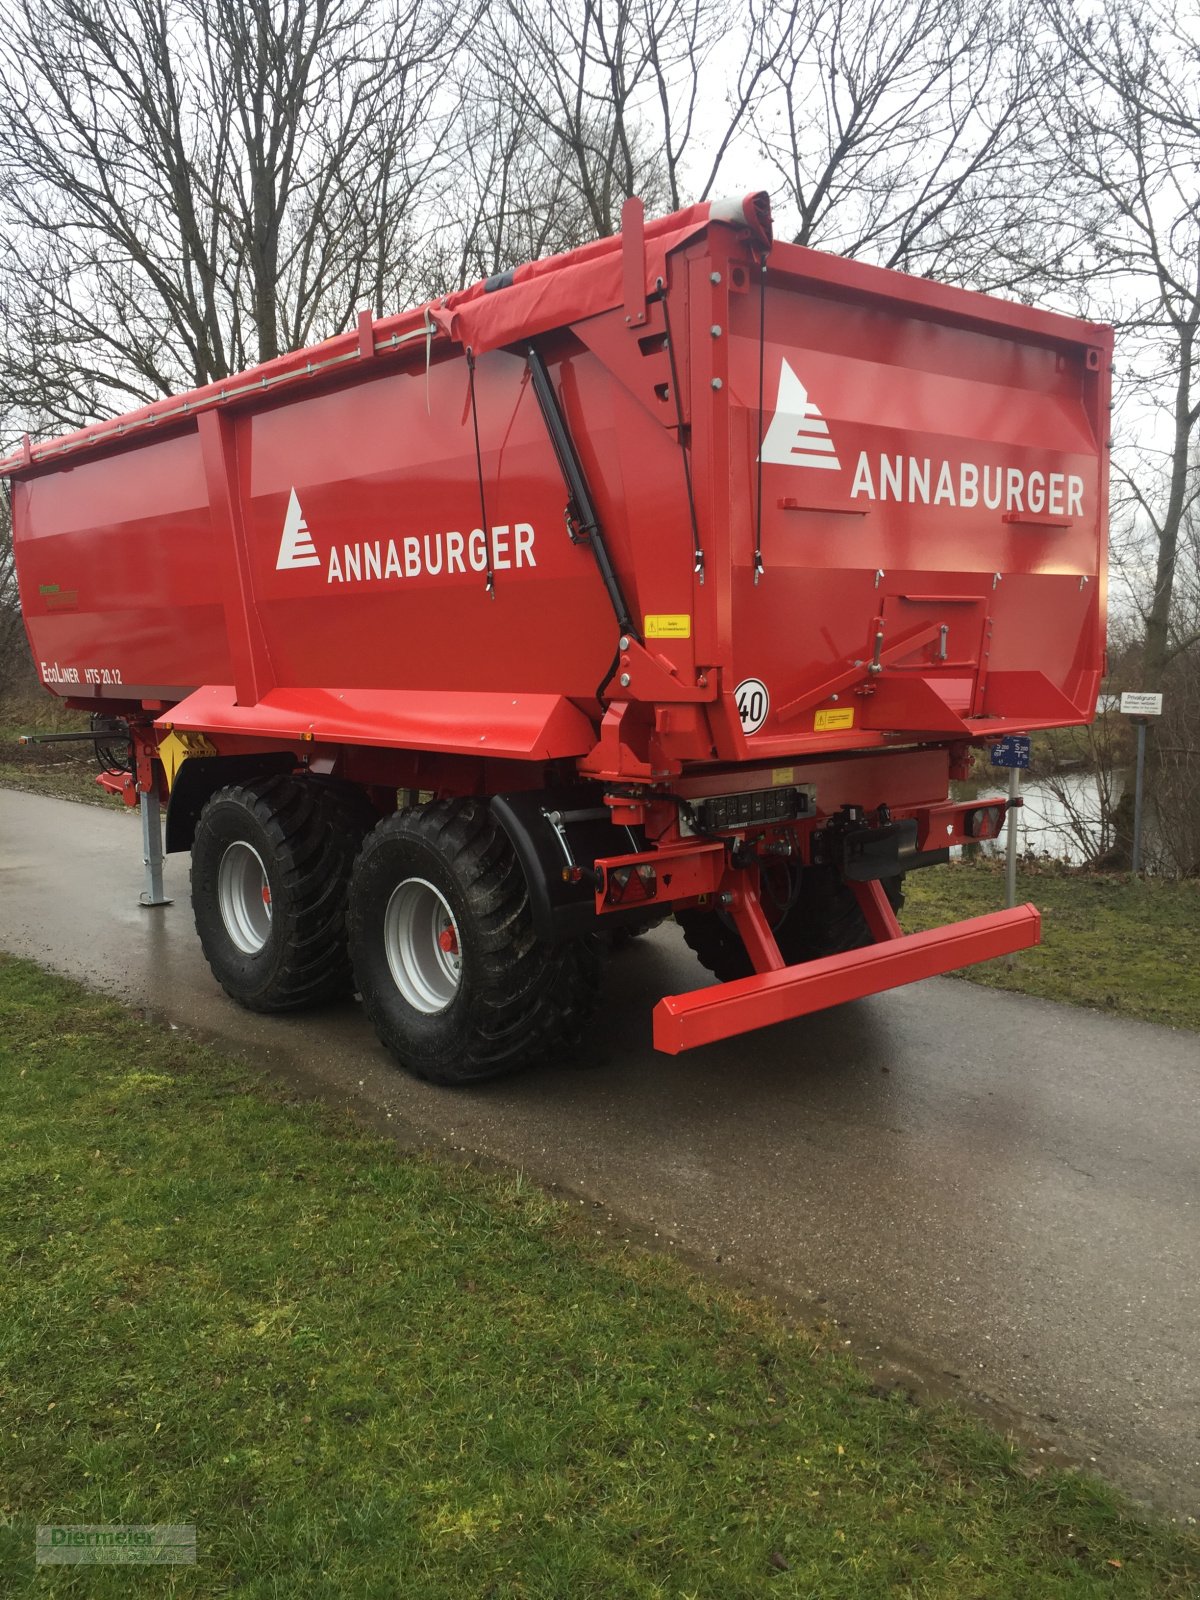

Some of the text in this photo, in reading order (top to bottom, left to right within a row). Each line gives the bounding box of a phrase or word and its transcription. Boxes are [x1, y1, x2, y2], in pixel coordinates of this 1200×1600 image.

[850, 451, 1084, 517] ANNABURGER
[327, 522, 537, 584] ANNABURGER
[84, 668, 100, 684] HTS
[101, 669, 123, 684] 20.12
[738, 691, 763, 723] 40
